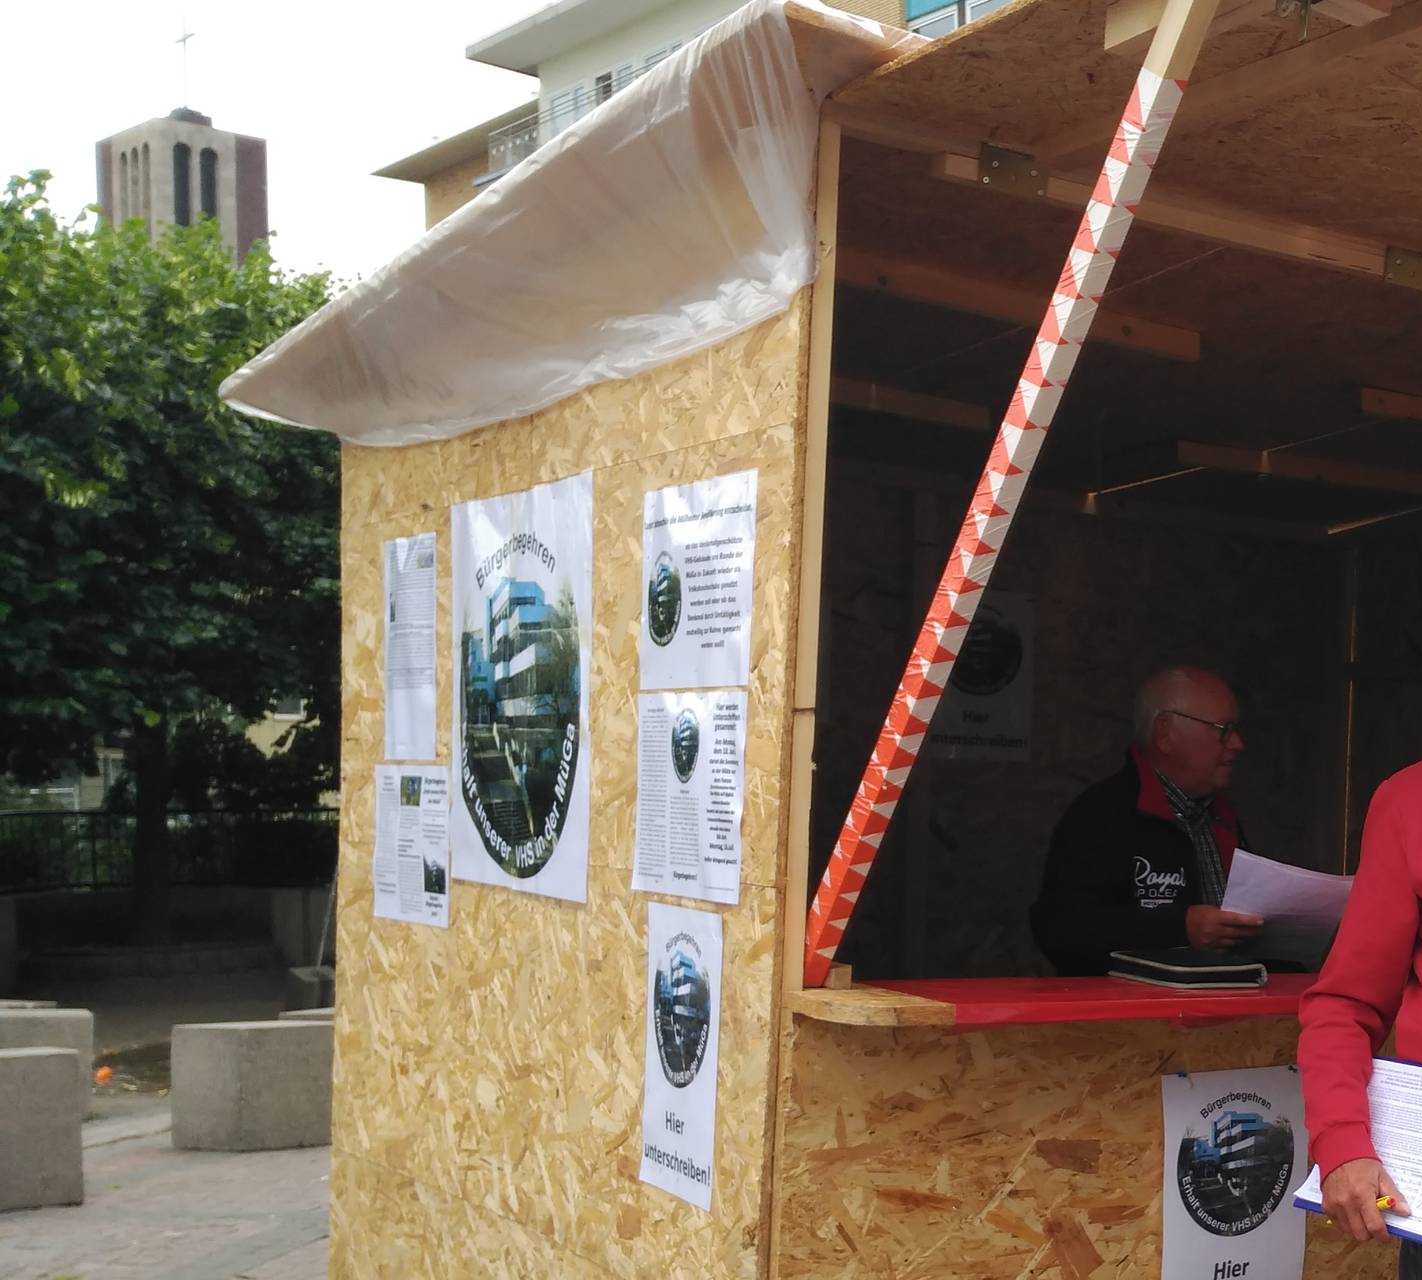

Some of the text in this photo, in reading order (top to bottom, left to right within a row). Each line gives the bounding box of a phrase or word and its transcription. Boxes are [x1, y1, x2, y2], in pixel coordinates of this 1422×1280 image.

[475, 531, 557, 589] Bürgerbegehren
[475, 797, 512, 861] unserer
[515, 842, 534, 869] VHS
[534, 834, 545, 859] in
[544, 800, 560, 840] der
[556, 722, 576, 803] MüGa
[665, 1110, 685, 1136] Hier
[1200, 1091, 1272, 1119] Bürgerbegehren
[644, 1143, 711, 1187] unterschreiben!
[1182, 1163, 1289, 1232] Erhalt unserer VHS in der MüGa
[1214, 1260, 1250, 1280] Hier
